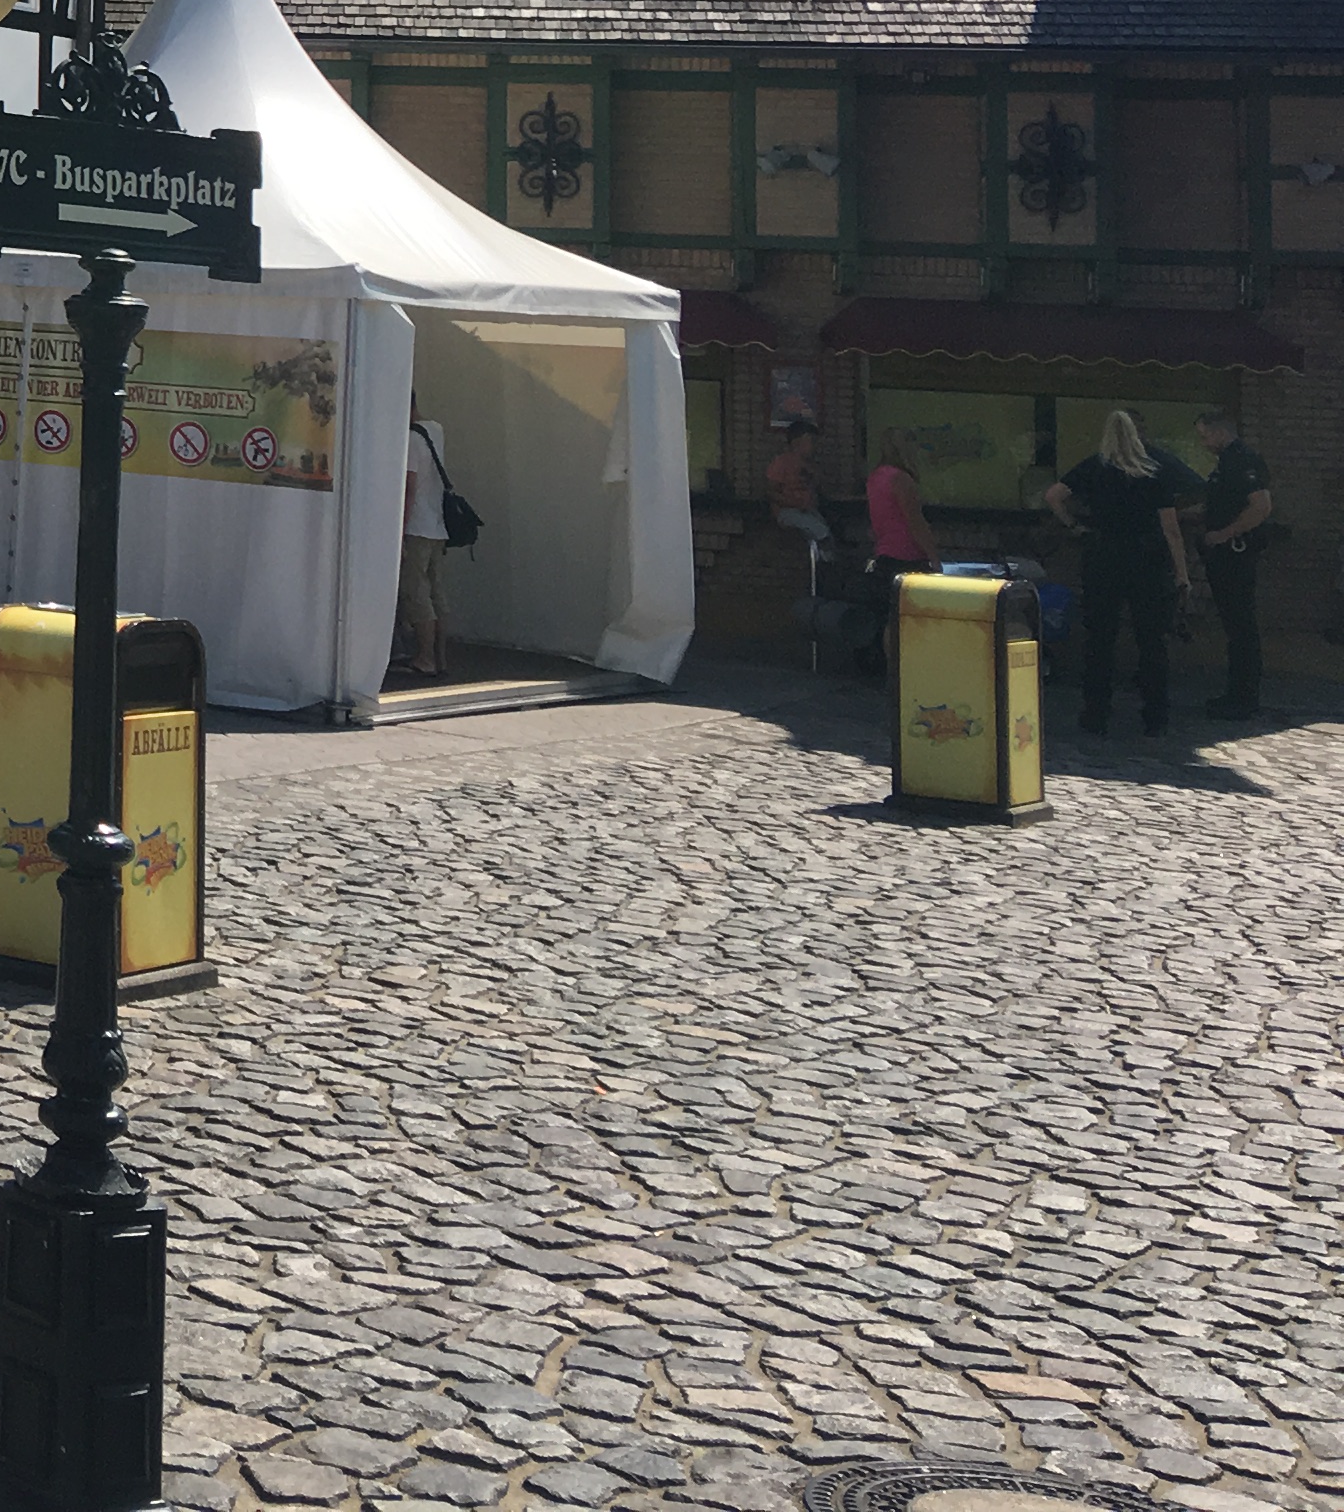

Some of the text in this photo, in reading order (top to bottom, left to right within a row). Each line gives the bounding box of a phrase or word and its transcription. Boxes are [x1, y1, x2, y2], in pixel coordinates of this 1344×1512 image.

[36, 169, 46, 179] -
[54, 154, 236, 210] Busparkplatz
[36, 379, 60, 397] DER
[174, 389, 250, 411] VERBOTEN:
[131, 722, 191, 756] ABFÄLLE
